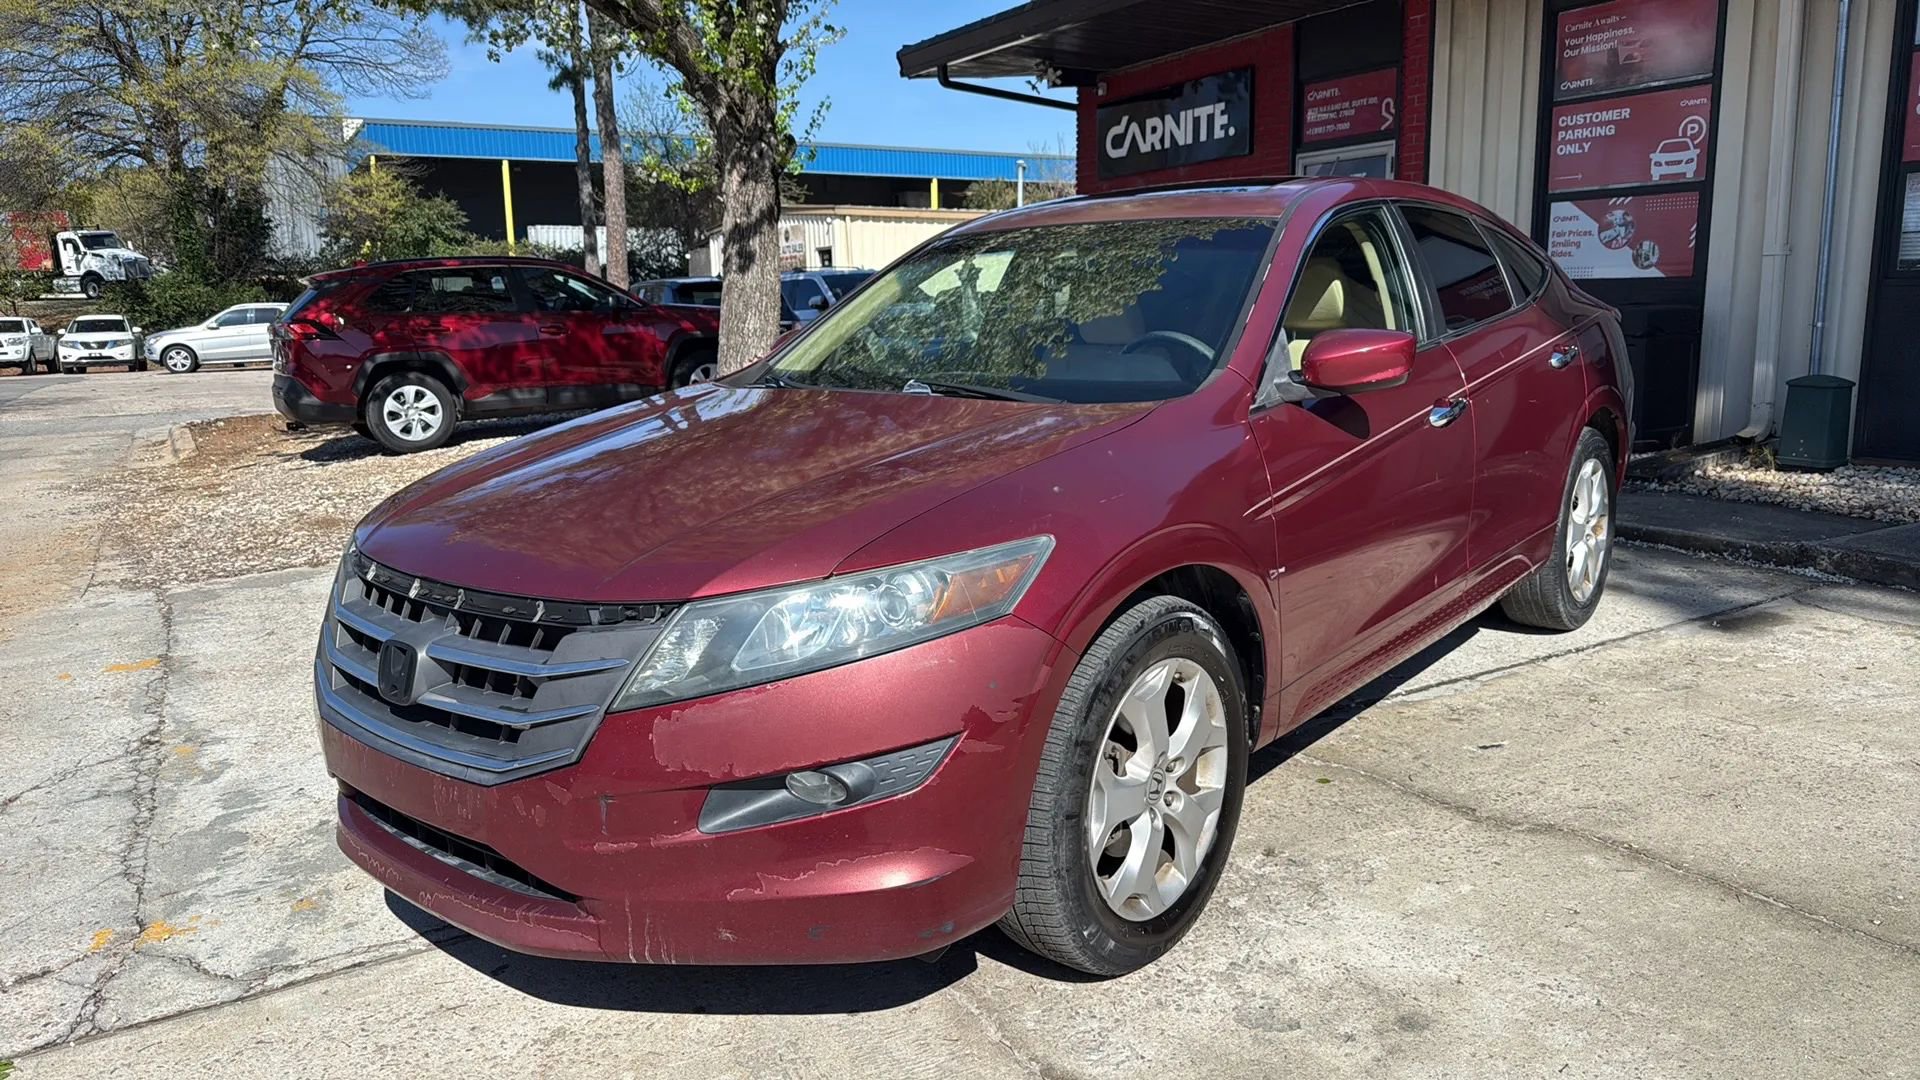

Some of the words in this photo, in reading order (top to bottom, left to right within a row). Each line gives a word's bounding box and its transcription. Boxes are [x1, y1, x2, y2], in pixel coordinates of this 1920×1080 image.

[1565, 21, 1593, 33] Carnite
[1594, 16, 1620, 26] Awaits
[1563, 48, 1580, 58] Our
[1581, 39, 1618, 54] Mission!
[1564, 37, 1585, 47] Your
[1558, 108, 1631, 127] CUSTOMER
[1557, 125, 1616, 141] PARKING
[1556, 142, 1591, 156] ONLY
[1552, 229, 1567, 238] Fair
[1567, 229, 1595, 237] Prices.
[1551, 239, 1581, 249] Smiling
[1550, 250, 1574, 258] Rides.
